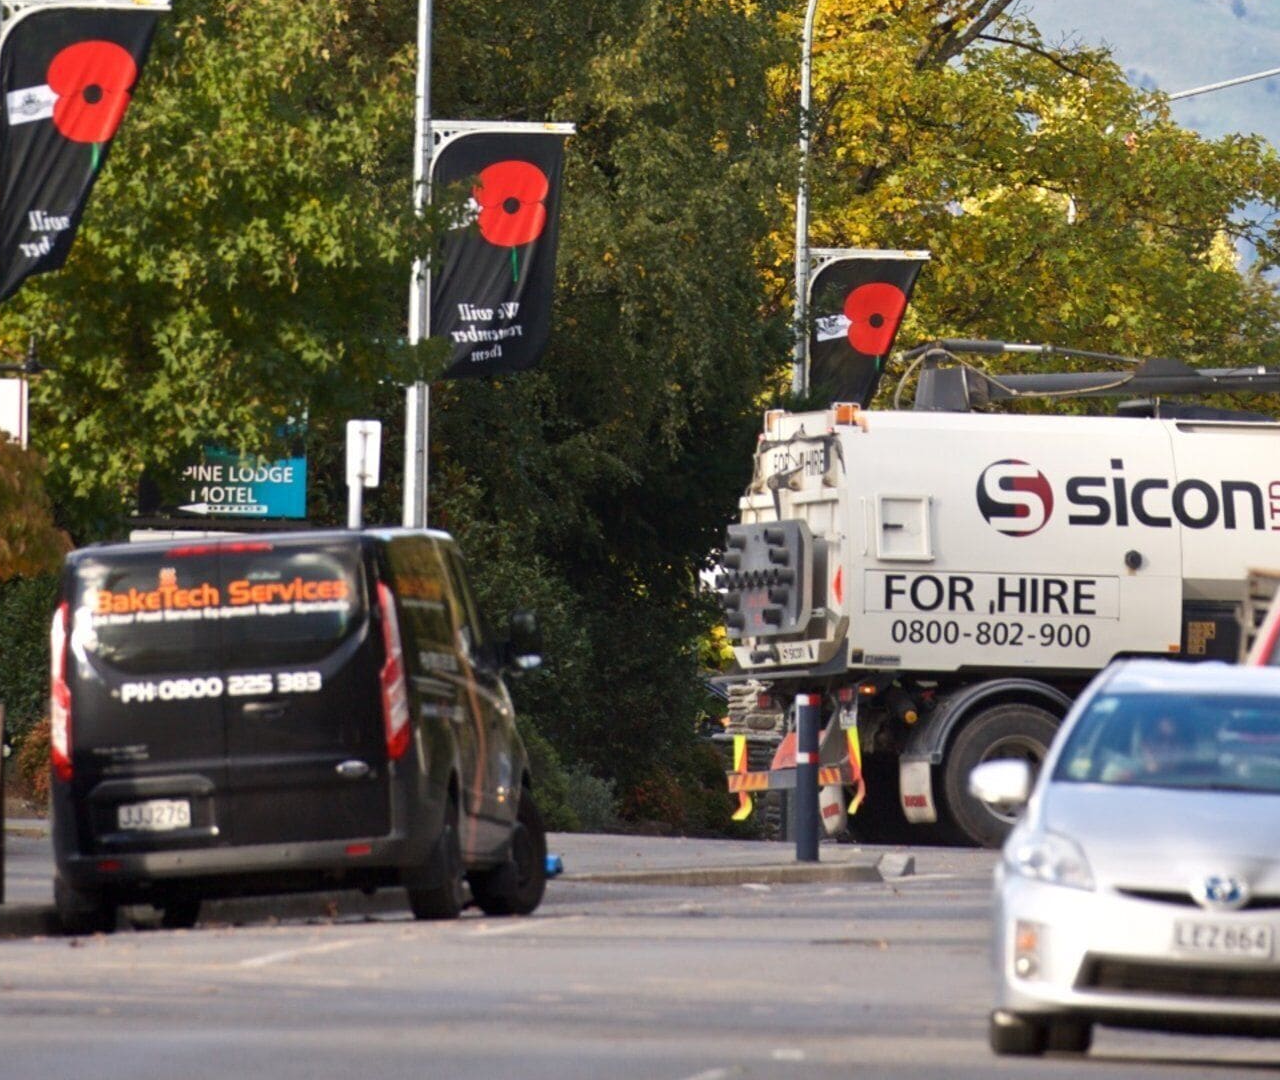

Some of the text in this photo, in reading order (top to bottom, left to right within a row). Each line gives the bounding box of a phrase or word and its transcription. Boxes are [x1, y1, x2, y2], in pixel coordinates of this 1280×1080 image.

[228, 465, 294, 483] LODGE
[1065, 458, 1266, 531] sicon
[97, 576, 350, 615] BakeTech Services
[884, 574, 1097, 616] FOR HIRE
[891, 620, 1091, 648] 0800-802-900
[228, 674, 273, 696] 225
[277, 671, 322, 693] 383
